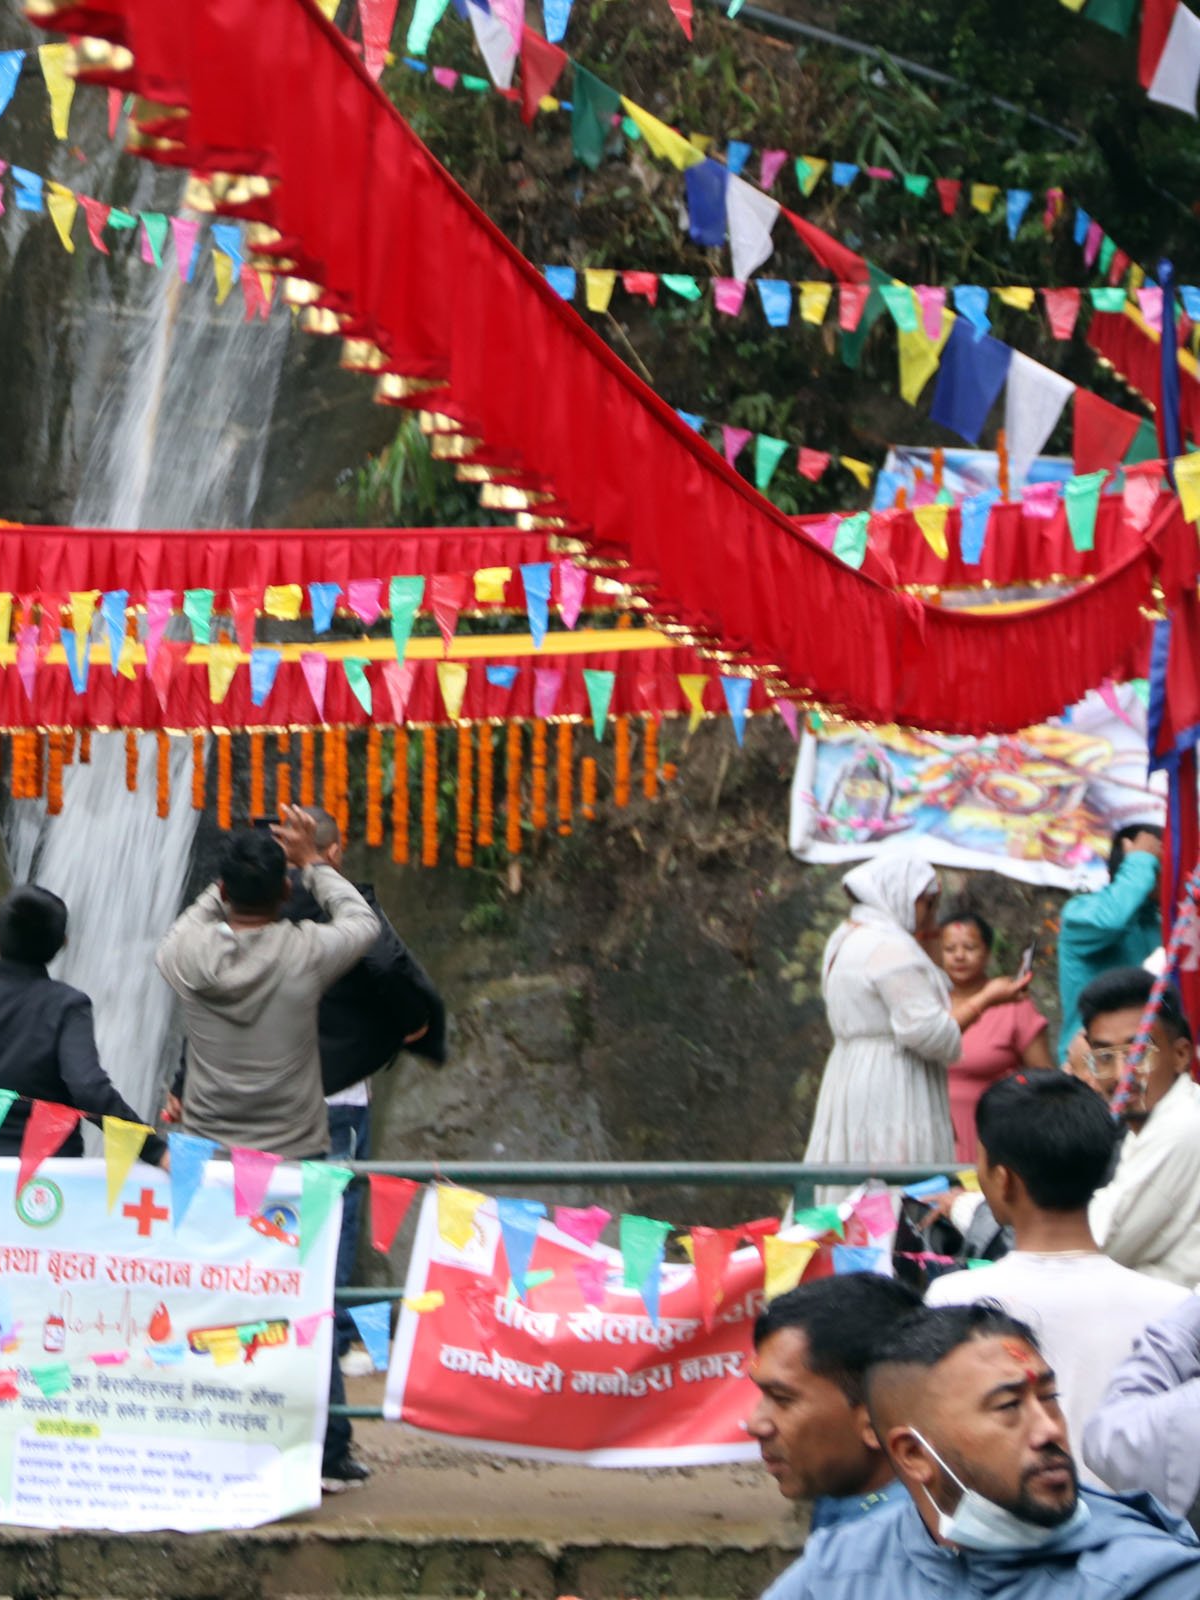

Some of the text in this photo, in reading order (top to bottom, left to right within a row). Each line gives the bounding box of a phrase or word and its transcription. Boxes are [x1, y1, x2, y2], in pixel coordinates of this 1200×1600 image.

[105, 1254, 193, 1288] रक्तदान
[199, 1258, 304, 1297] कार्यक्रम
[678, 1350, 746, 1383] नगर
